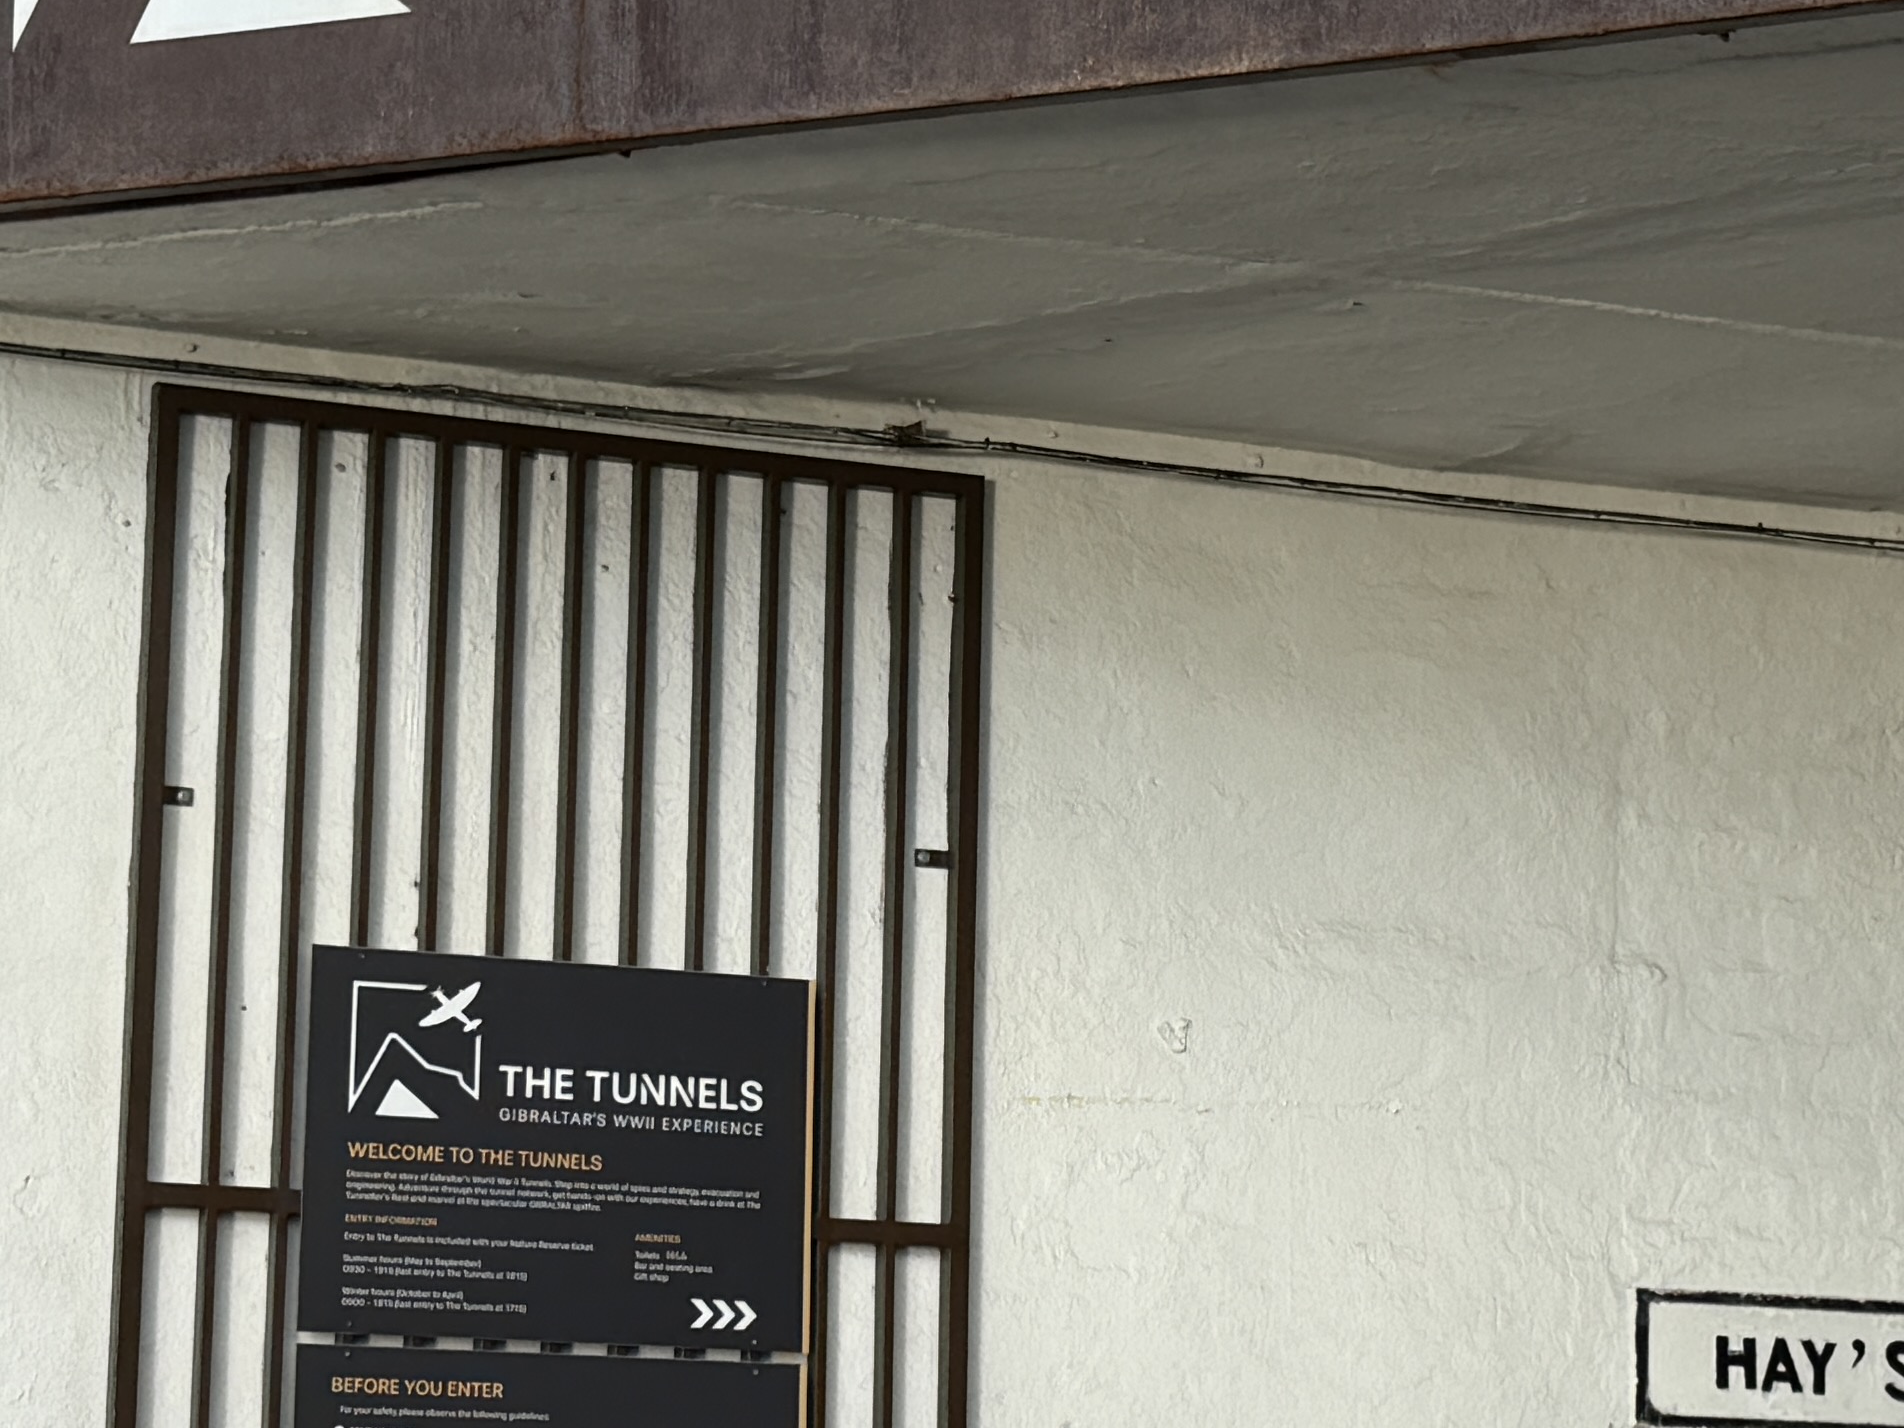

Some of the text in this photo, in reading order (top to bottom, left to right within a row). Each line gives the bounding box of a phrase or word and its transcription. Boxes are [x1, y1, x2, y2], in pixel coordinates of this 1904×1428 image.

[498, 1064, 763, 1112] THE TUNNELS
[498, 1108, 764, 1137] GIBRALTAR'S WWII EXPERIENCE
[347, 1141, 603, 1171] WELCOME TO THE TUNNELS
[331, 1376, 504, 1399] BEFORE YOU ENTER
